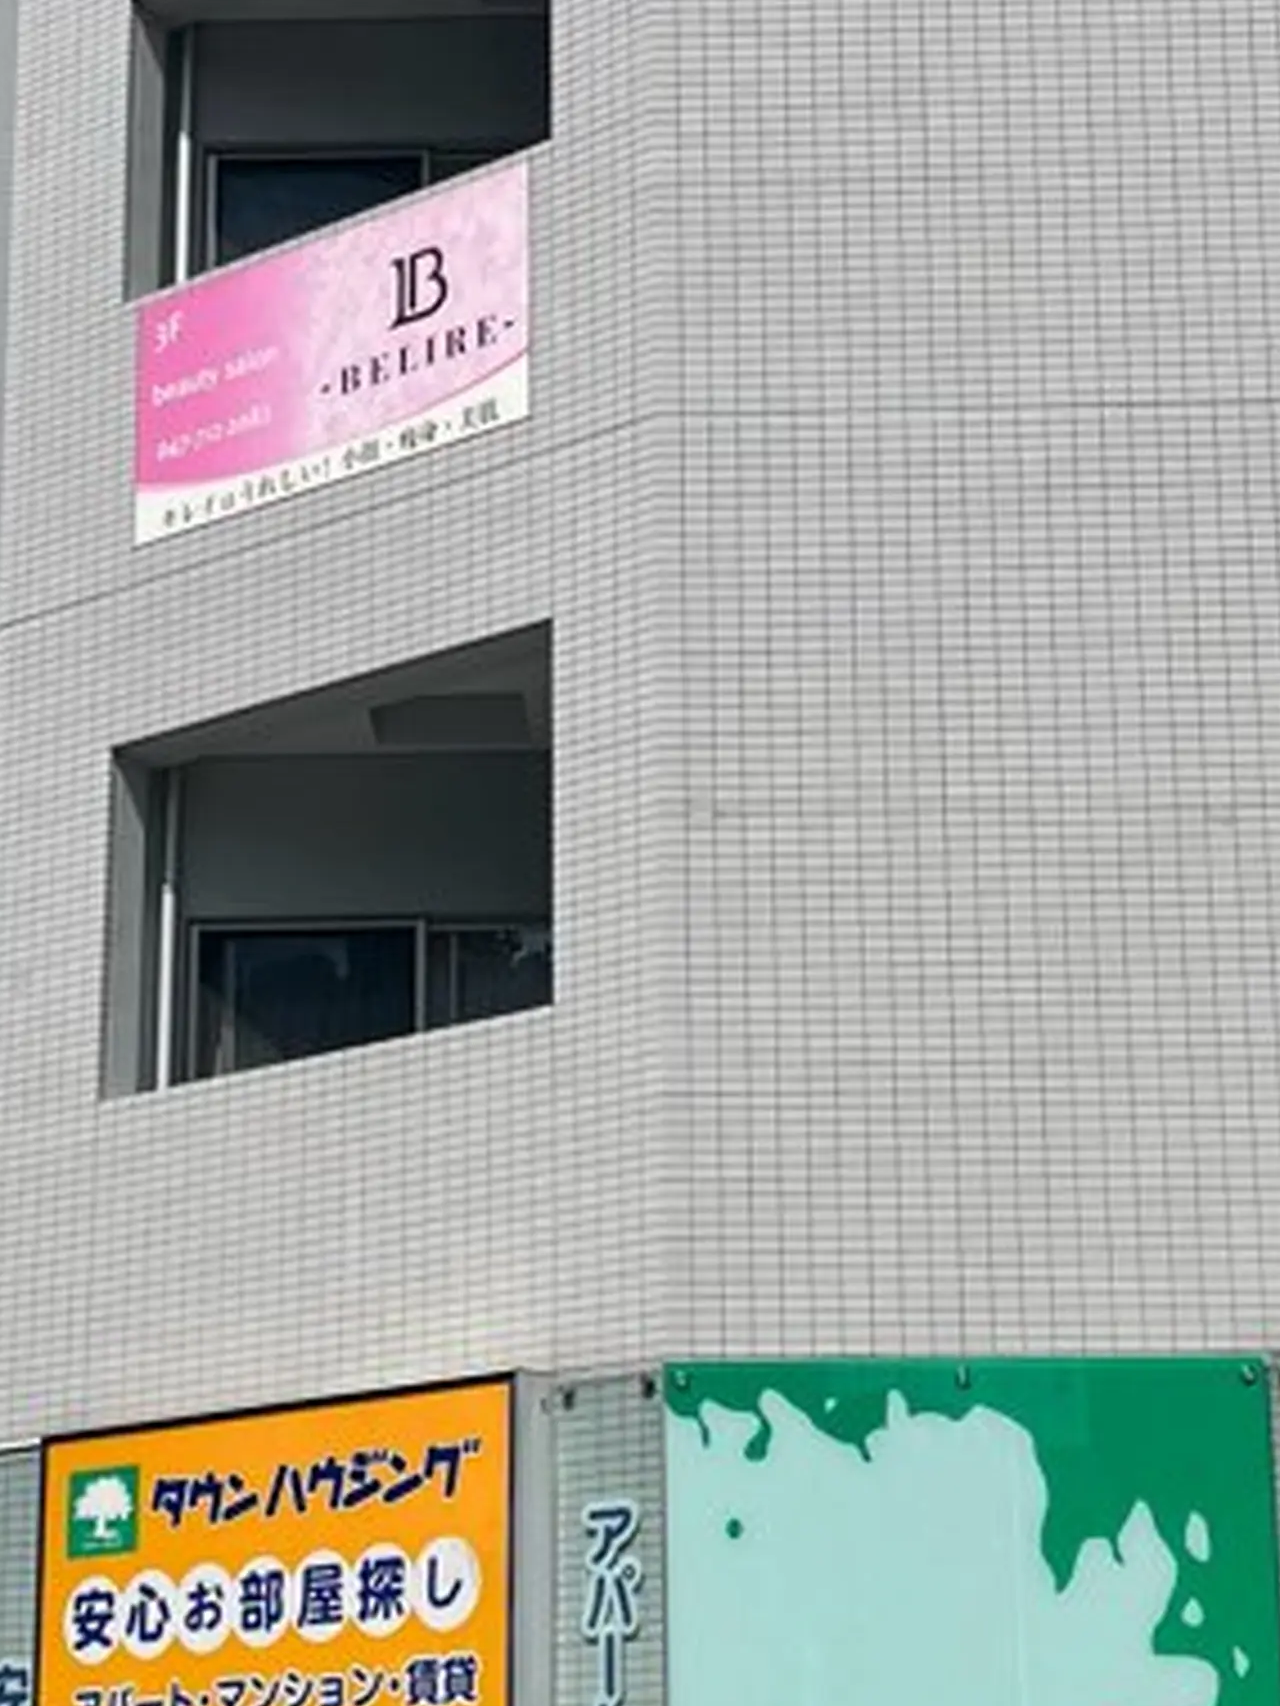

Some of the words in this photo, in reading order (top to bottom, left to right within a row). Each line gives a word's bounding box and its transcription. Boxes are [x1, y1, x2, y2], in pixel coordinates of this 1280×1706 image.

[152, 1440, 481, 1527] タウンハウジング
[72, 1555, 464, 1652] 安心お部屋探し
